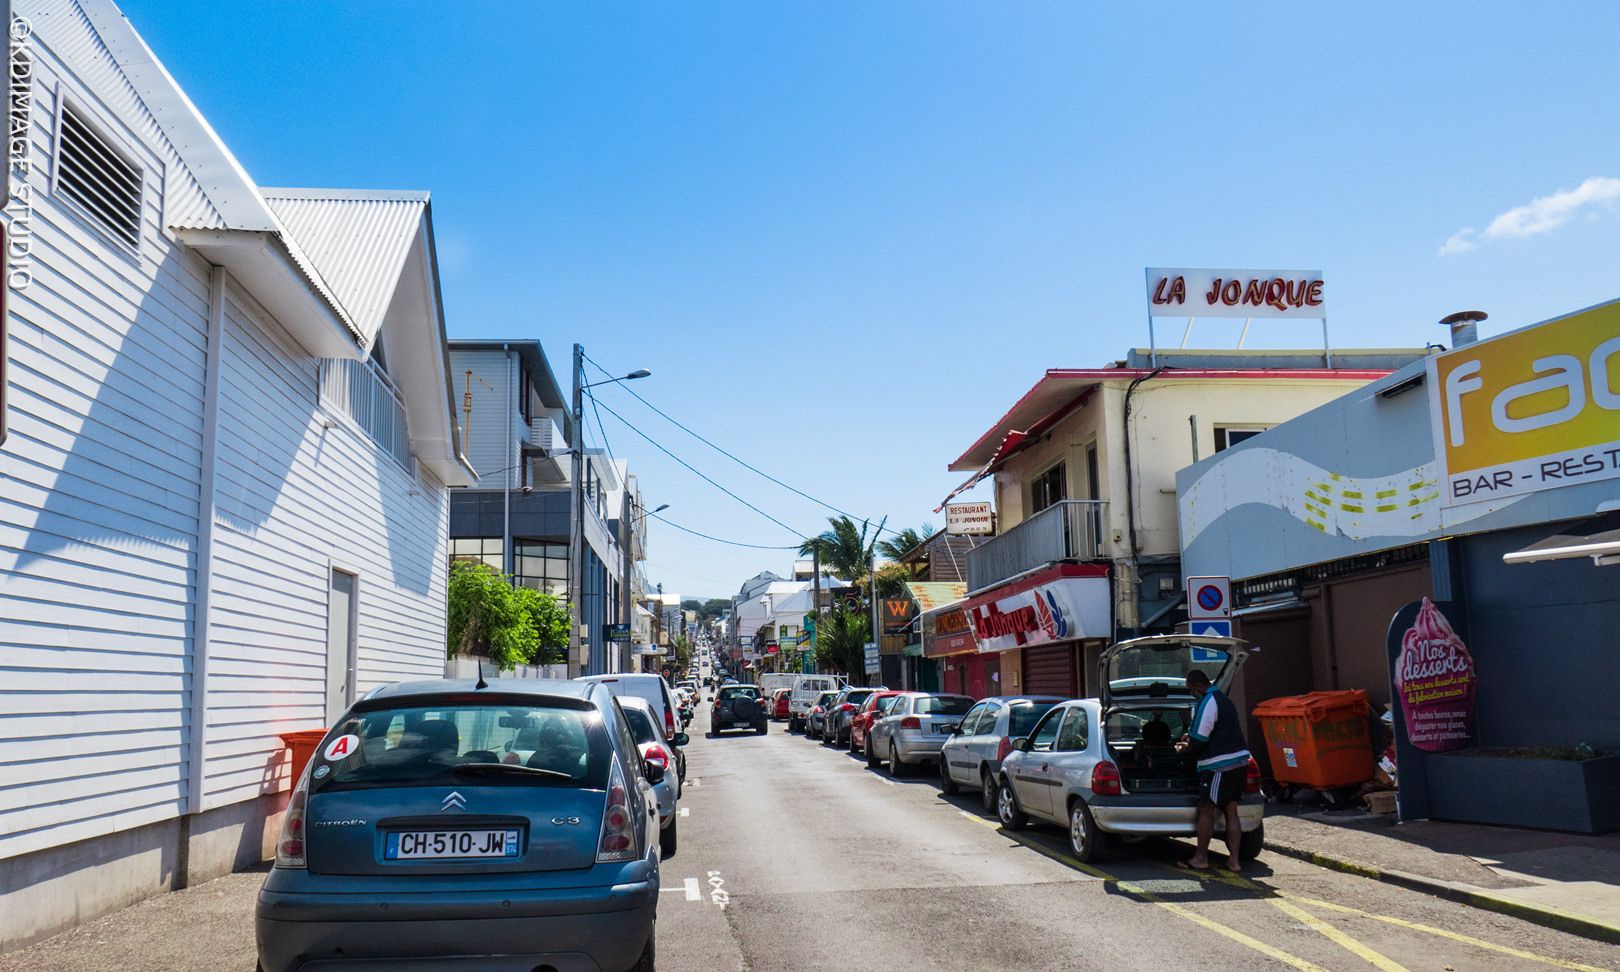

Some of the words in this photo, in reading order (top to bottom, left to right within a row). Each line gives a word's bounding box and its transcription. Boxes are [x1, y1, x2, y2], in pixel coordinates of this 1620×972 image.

[1152, 275, 1186, 305] LA
[1206, 277, 1325, 312] JONQUE
[1453, 470, 1513, 498] BAR
[949, 505, 988, 515] RESTAURANT
[887, 600, 909, 617] W
[1417, 640, 1446, 662] Nos
[1404, 646, 1468, 681] desserts
[330, 737, 348, 757] A
[551, 816, 580, 825] C3
[401, 832, 504, 854] CH-510-JW
